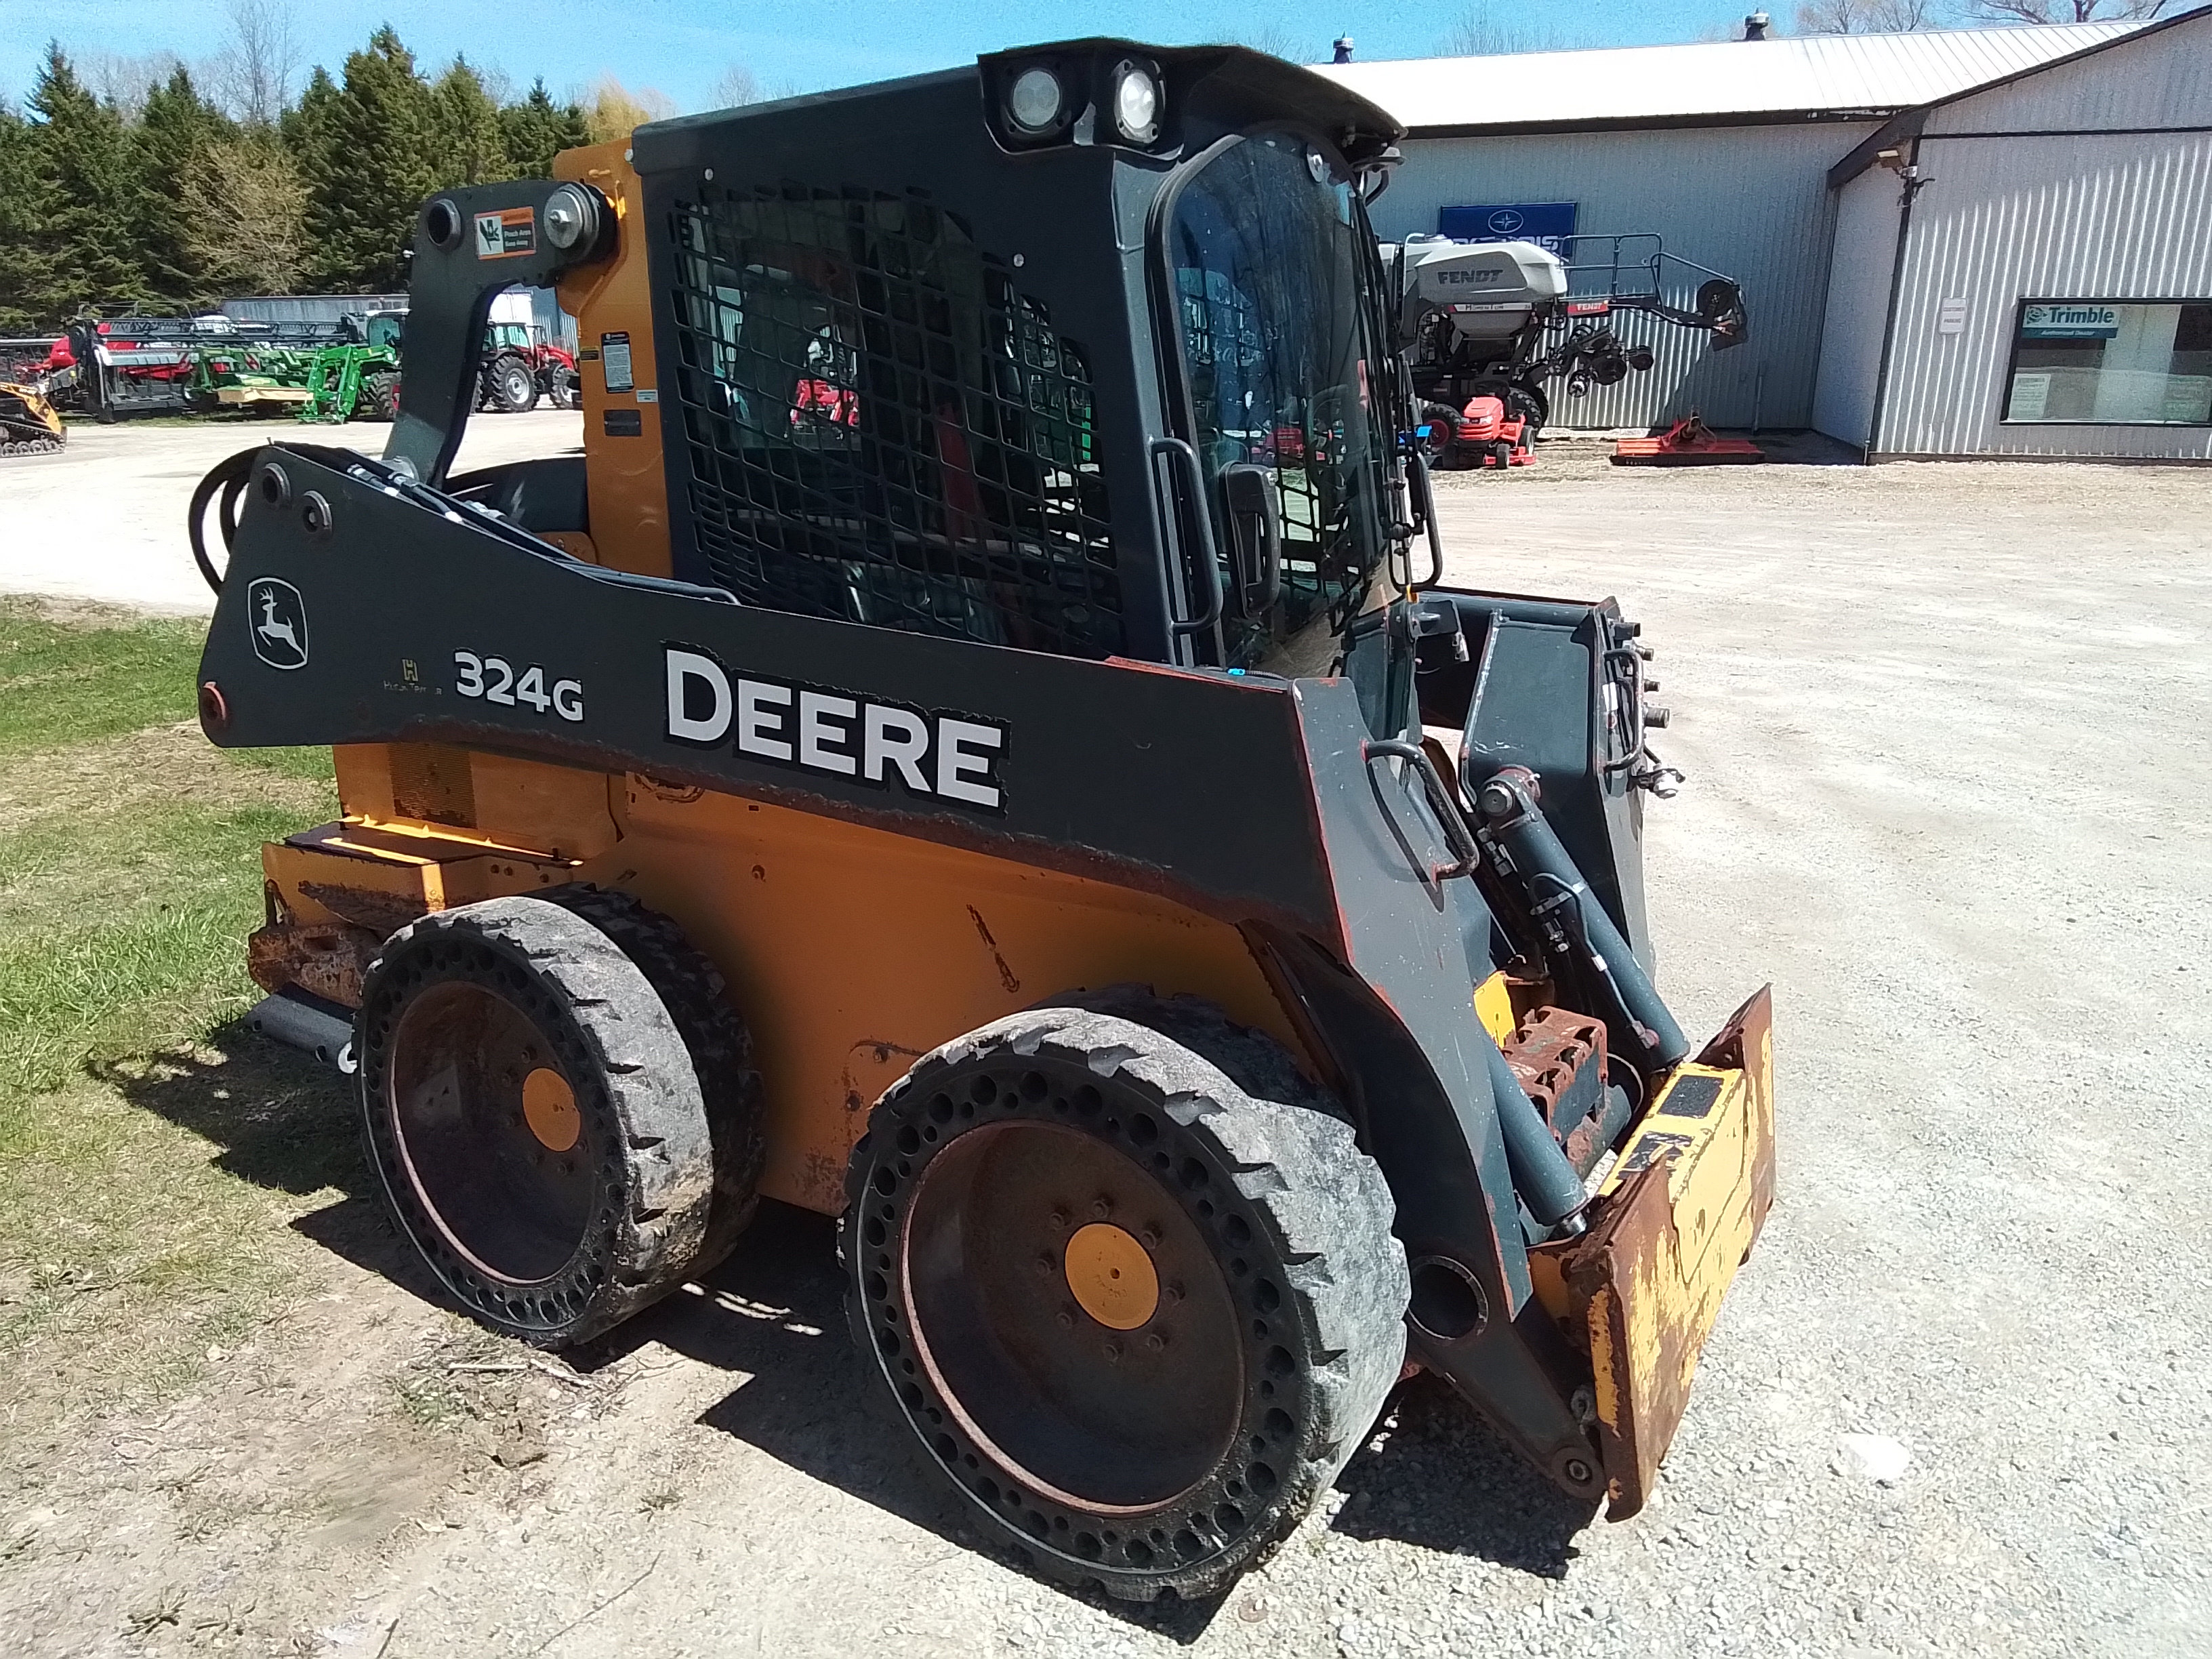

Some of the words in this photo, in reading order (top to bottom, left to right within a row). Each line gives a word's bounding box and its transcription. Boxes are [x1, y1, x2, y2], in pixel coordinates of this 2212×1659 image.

[1437, 269, 1504, 285] FENDT
[2048, 306, 2115, 323] Trimble
[454, 651, 583, 722] 324G
[665, 649, 1002, 808] DEERE
